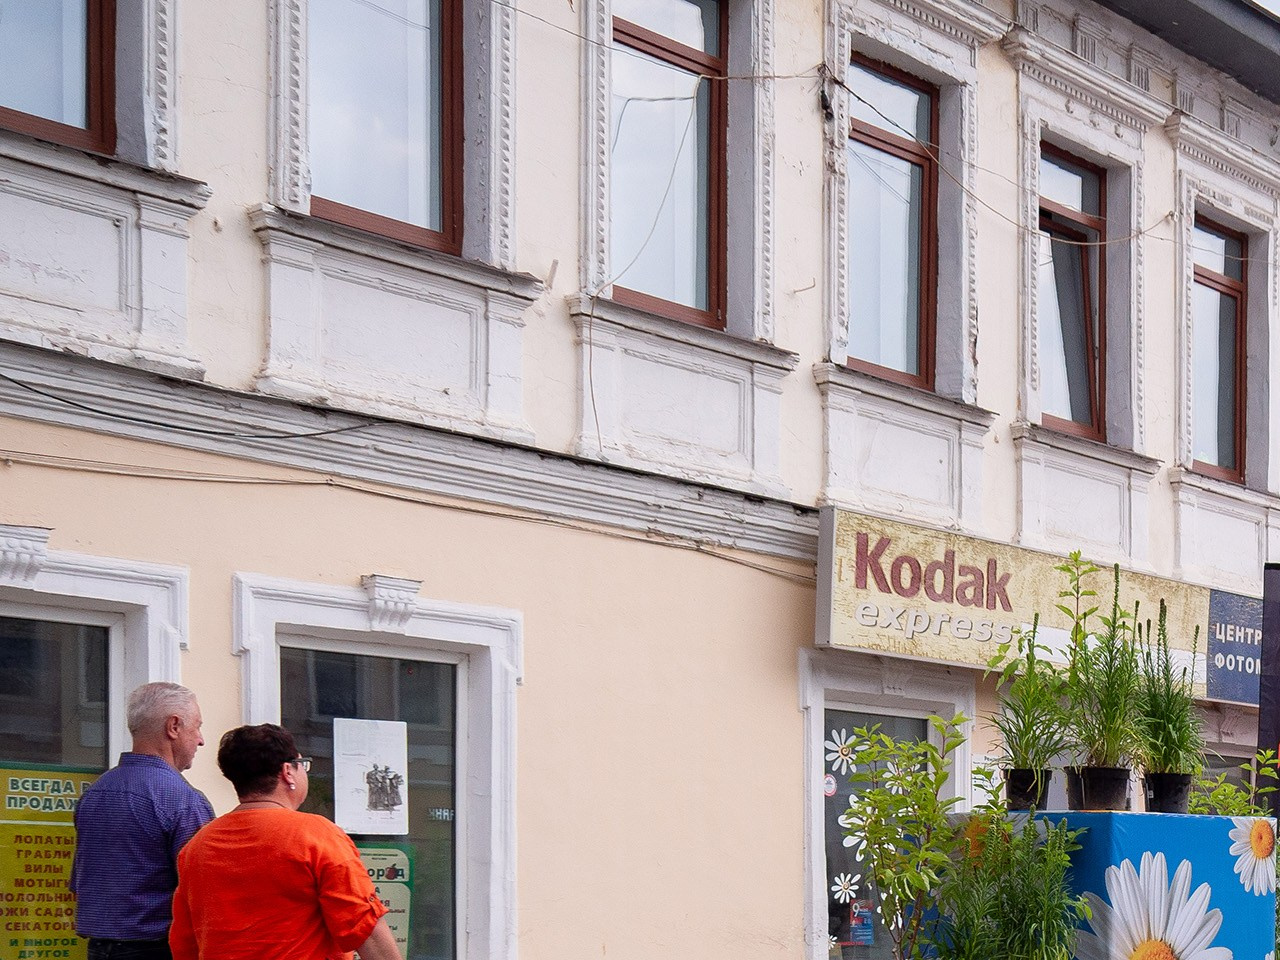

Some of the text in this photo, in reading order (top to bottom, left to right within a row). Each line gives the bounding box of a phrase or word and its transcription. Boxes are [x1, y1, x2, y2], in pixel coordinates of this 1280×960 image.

[854, 530, 1013, 612] Kodak
[854, 601, 1013, 645] express
[1215, 622, 1262, 645] ЦЕНТР
[9, 777, 76, 795] ВСЕГДА
[6, 795, 78, 812] ПРОДАЖ
[14, 835, 75, 846] ЛОПАТЫ
[16, 849, 72, 860] ГРАБЛИ
[24, 864, 64, 874] ВИЛЫ
[35, 907, 74, 918] САДО
[9, 938, 78, 947] И МНОГОЕ
[18, 949, 70, 959] ДРУГОЕ
